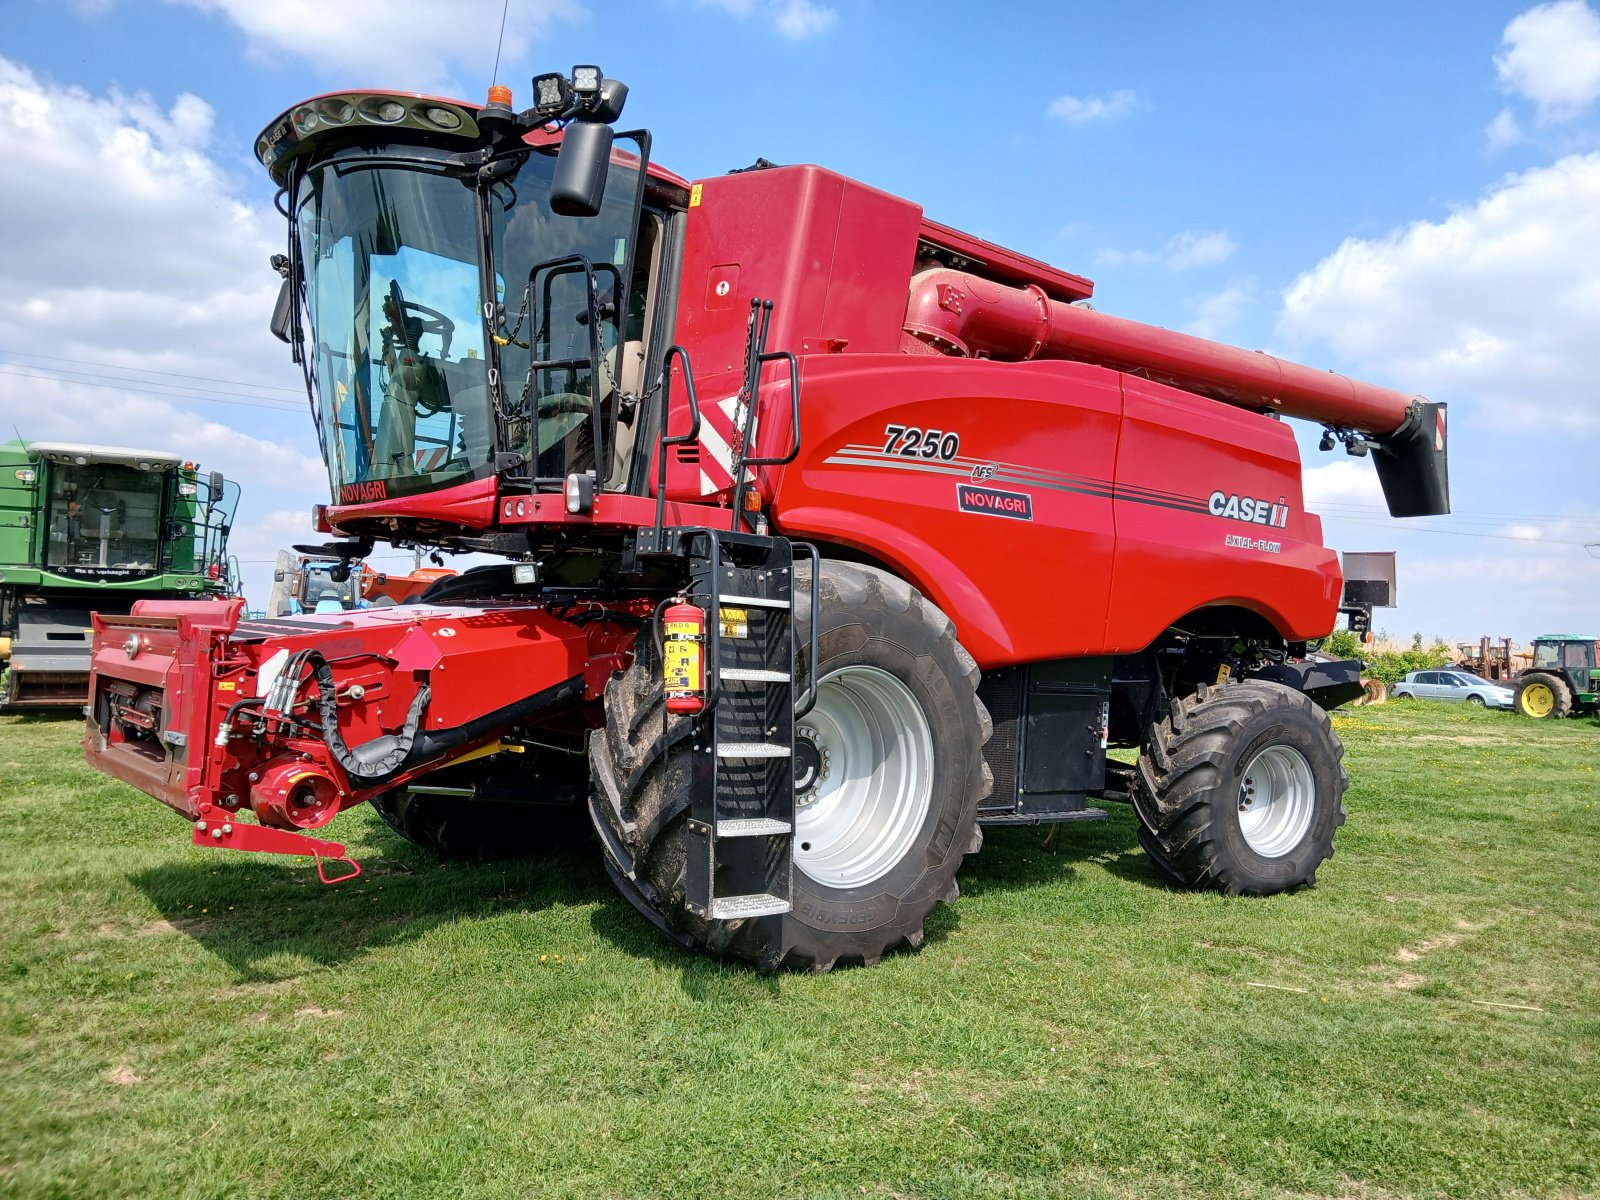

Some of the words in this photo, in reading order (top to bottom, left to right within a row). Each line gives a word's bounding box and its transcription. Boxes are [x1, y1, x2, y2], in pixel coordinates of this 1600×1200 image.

[882, 423, 960, 462] 7250
[972, 464, 993, 479] AFS
[340, 480, 387, 503] NOVAGRI
[964, 491, 1027, 514] NOVAGRI
[1208, 490, 1270, 525] CASE
[1224, 534, 1281, 553] AXIAL-FLOW
